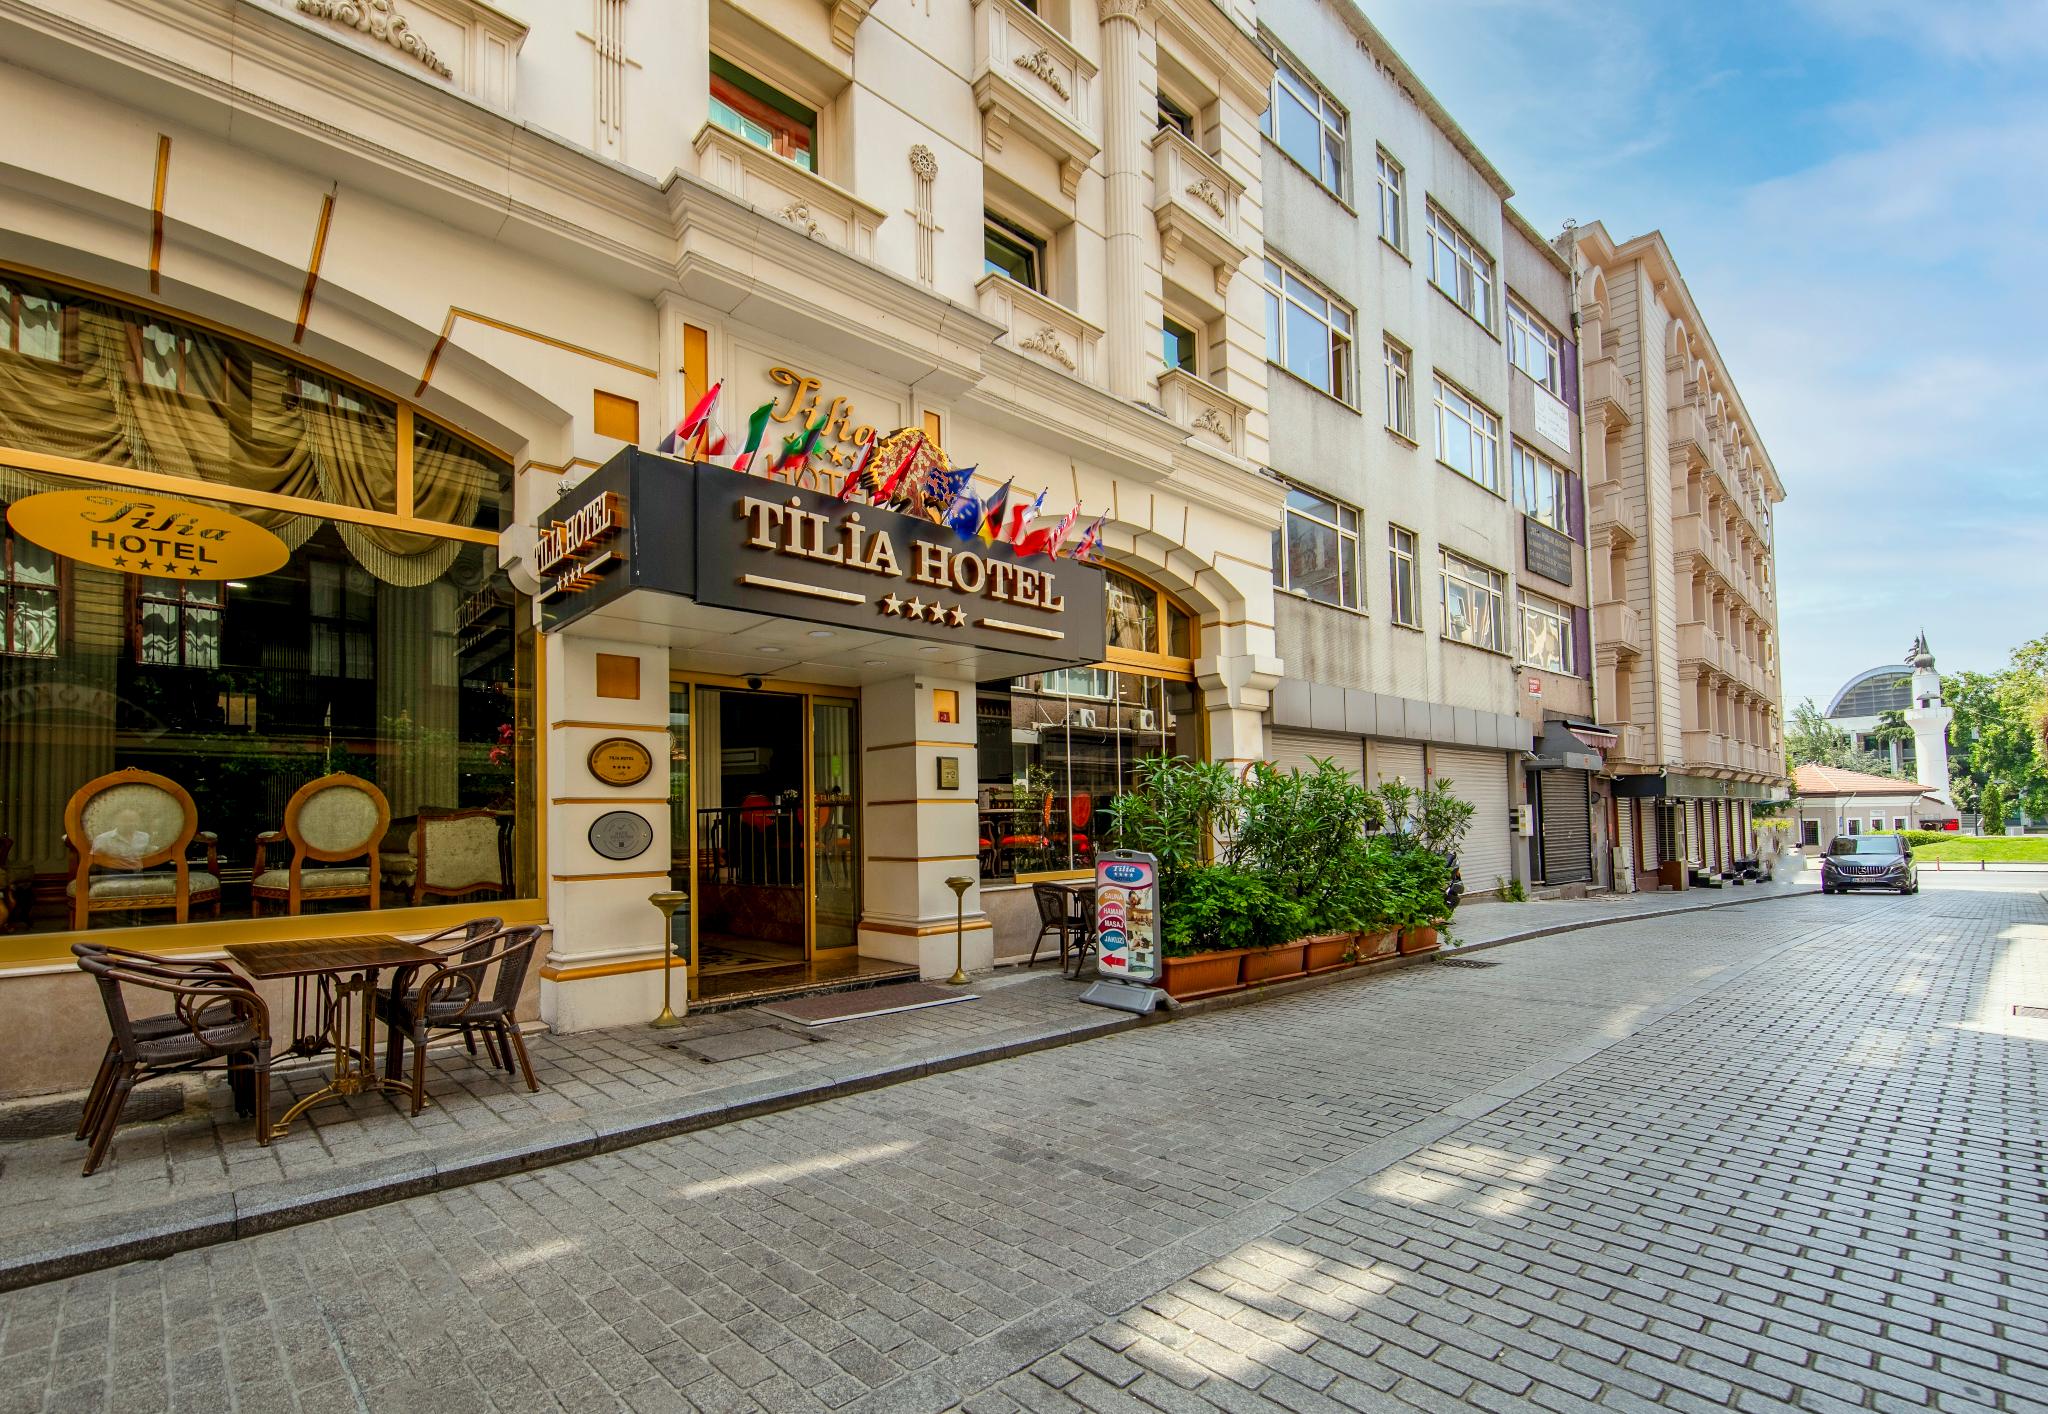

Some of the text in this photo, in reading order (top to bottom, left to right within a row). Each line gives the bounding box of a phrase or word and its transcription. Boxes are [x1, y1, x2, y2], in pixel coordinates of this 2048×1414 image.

[769, 367, 873, 446] Tilia
[80, 495, 231, 541] Tilia
[565, 491, 612, 554] HOTEL
[91, 530, 217, 564] HOTEL
[915, 540, 1064, 613] HOTEL
[1103, 907, 1124, 916] HAMAM
[1104, 892, 1123, 900] SAUNA
[1104, 920, 1124, 928] MASAJ
